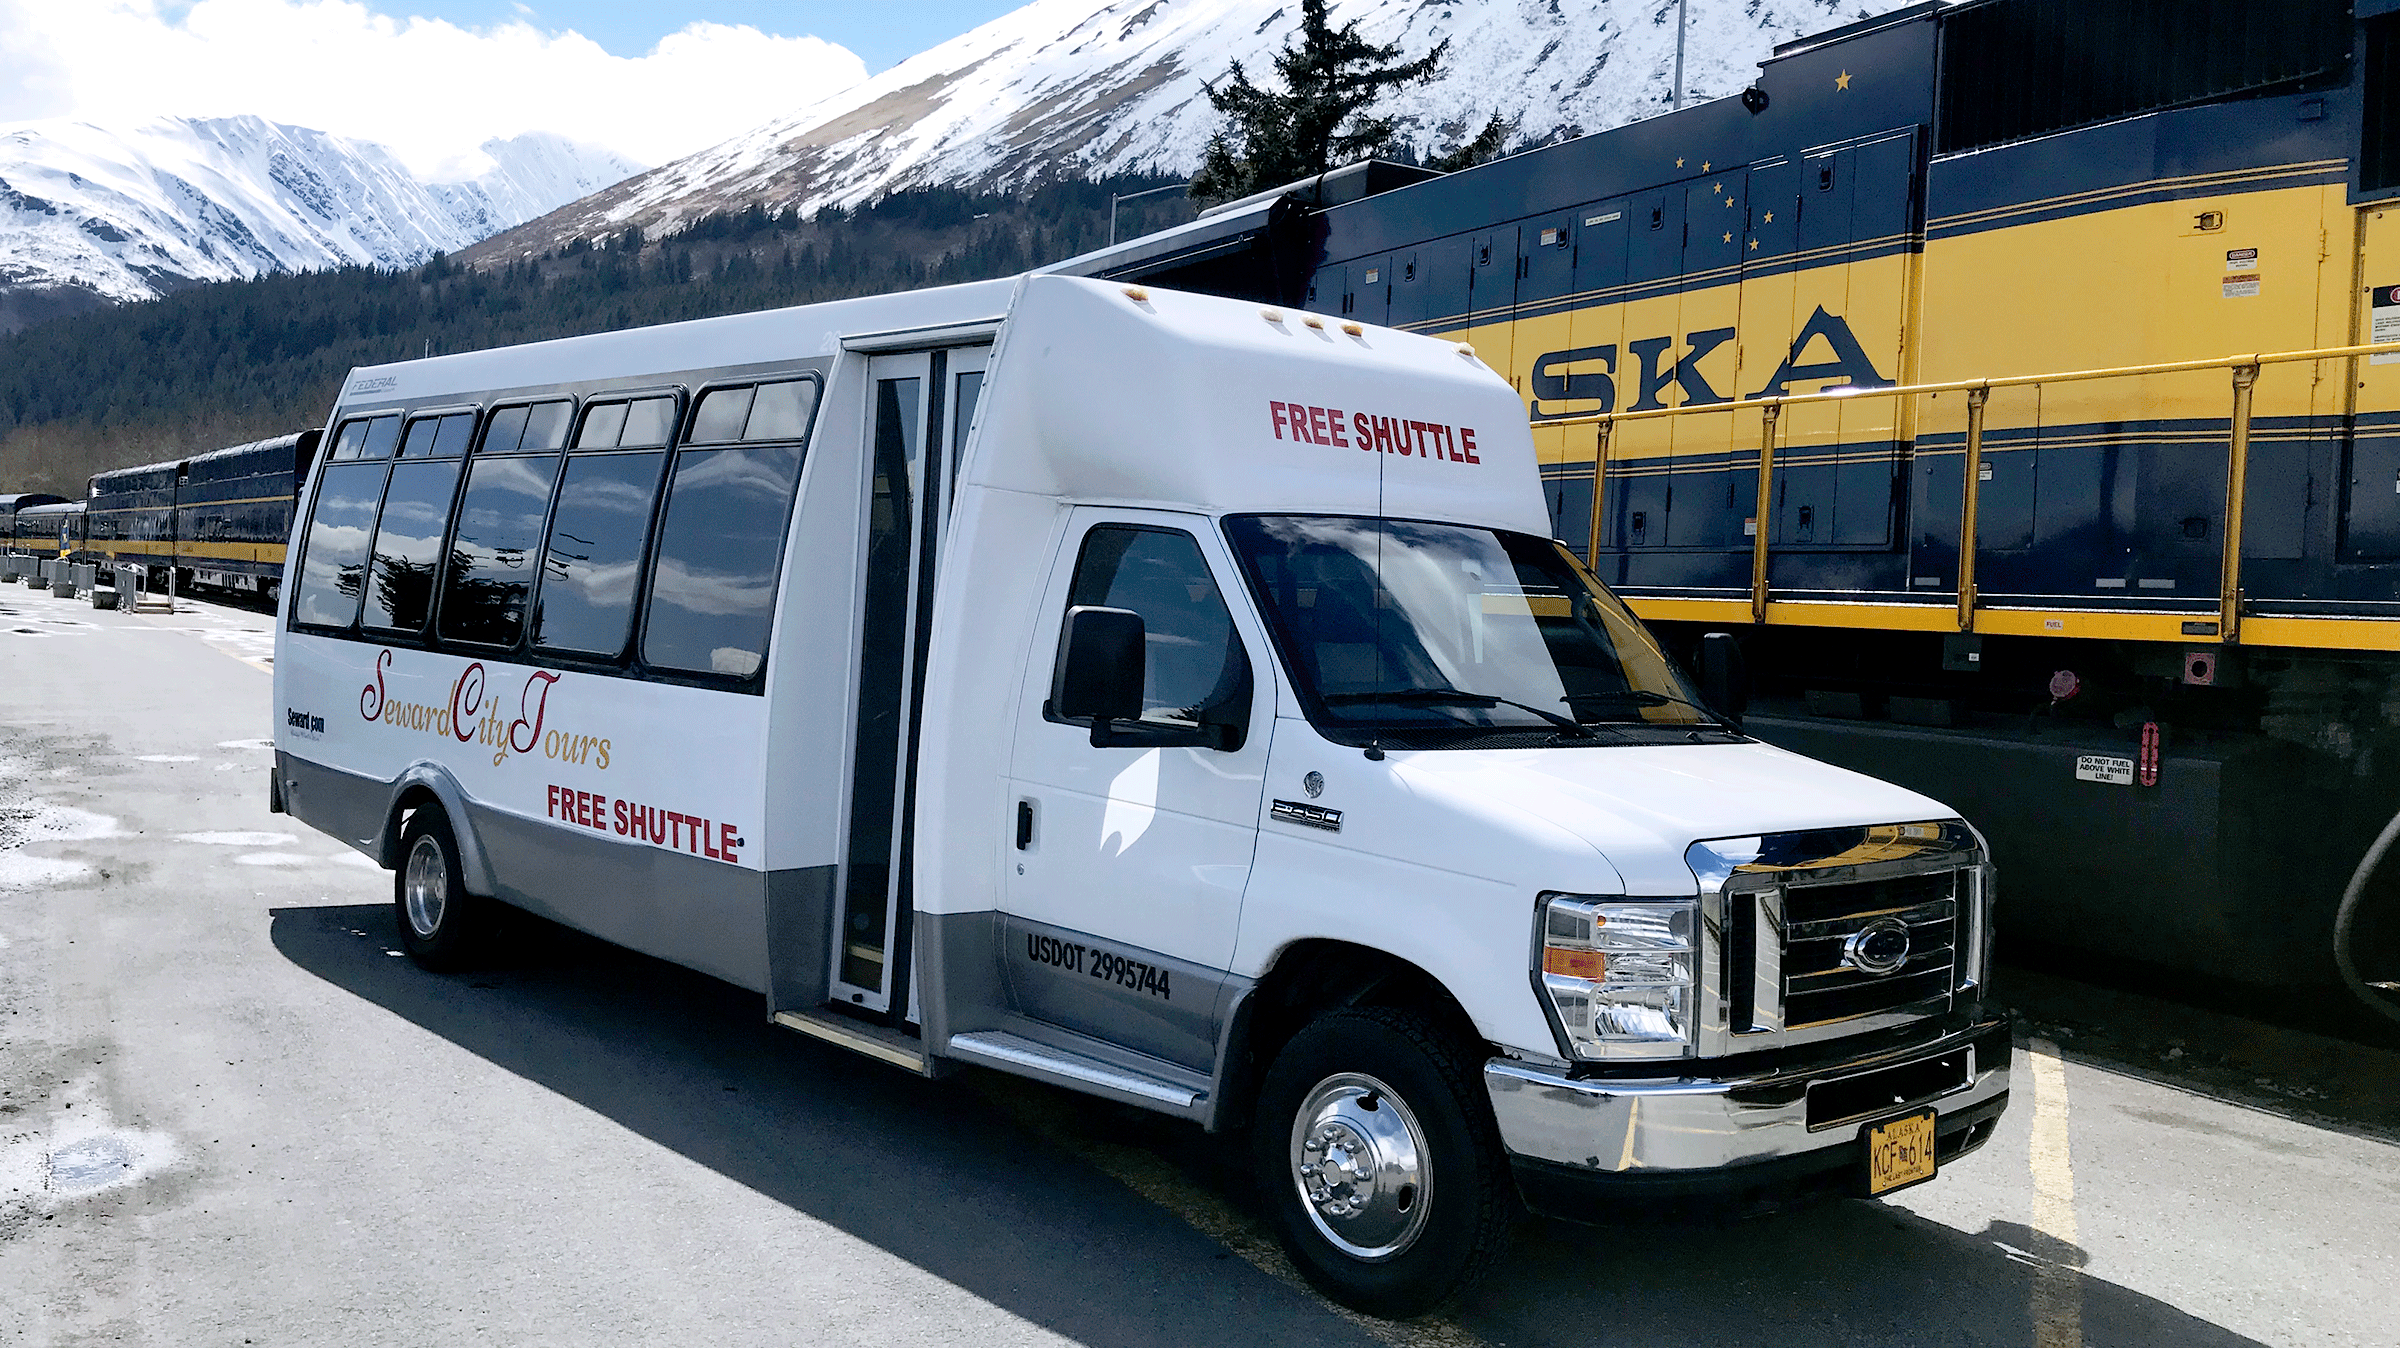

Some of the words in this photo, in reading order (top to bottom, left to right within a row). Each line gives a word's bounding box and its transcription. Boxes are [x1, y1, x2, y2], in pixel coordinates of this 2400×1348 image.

[353, 376, 397, 390] FEDERAL
[1269, 400, 1349, 448] FREE
[1353, 412, 1480, 465] SHUTTLE
[2079, 764, 2104, 773] ABOVE
[2106, 766, 2130, 776] WHITE
[2081, 756, 2093, 764] DO
[2095, 758, 2110, 766] NOT
[2112, 760, 2130, 768] FUEL
[548, 784, 607, 831] FREE
[614, 799, 738, 864] SHUTTLE
[1027, 933, 1086, 974] USDOT
[1090, 949, 1171, 1000] 2995744
[1886, 1123, 1920, 1141] ALASKA
